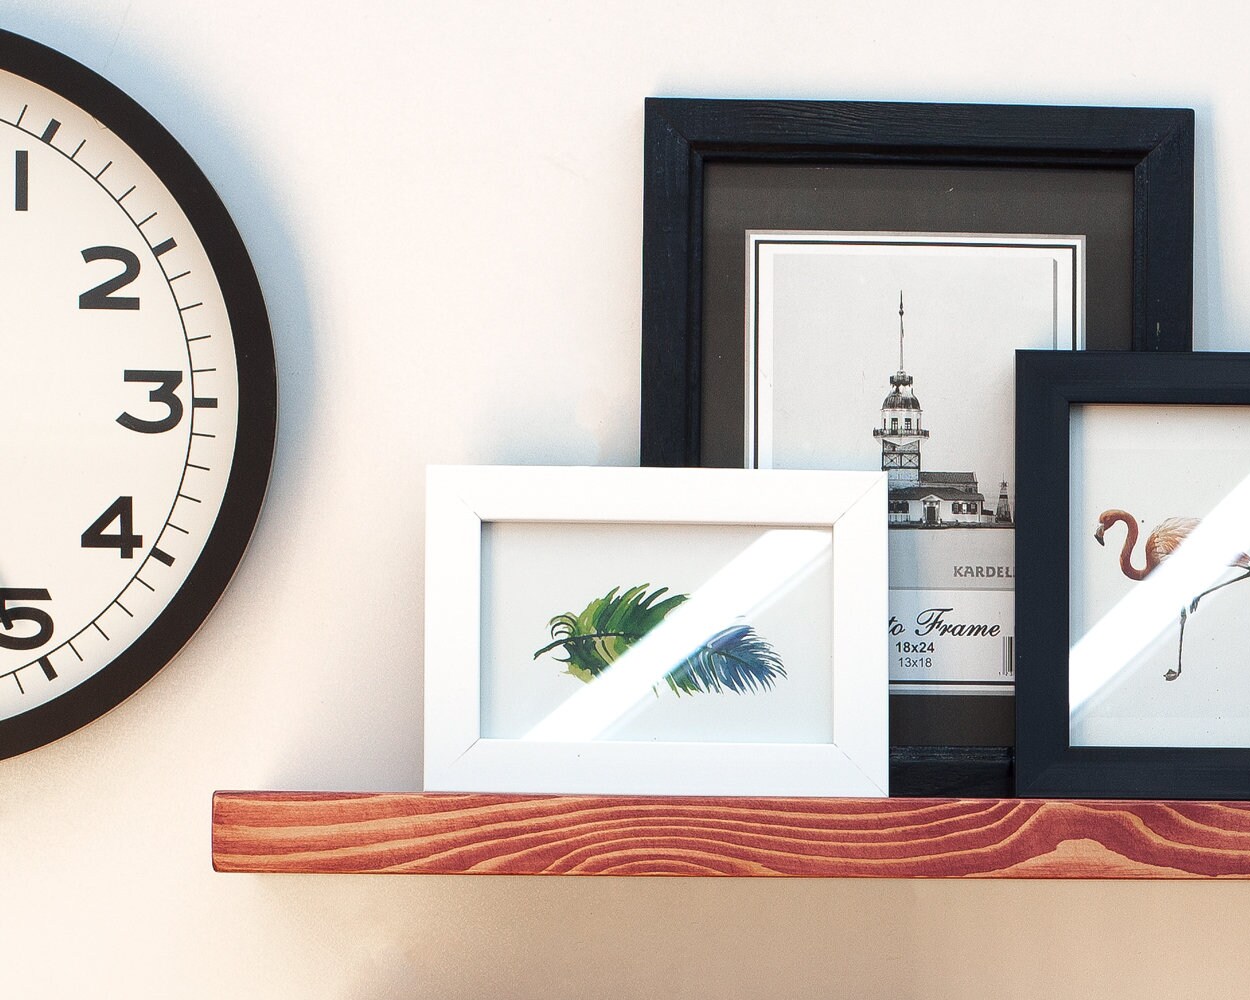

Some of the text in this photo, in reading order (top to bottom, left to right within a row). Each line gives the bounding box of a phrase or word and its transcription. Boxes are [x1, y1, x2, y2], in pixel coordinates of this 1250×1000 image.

[79, 246, 140, 309] 2
[116, 370, 183, 433] 3
[81, 497, 143, 558] 4
[953, 566, 1015, 578] KARDEL
[0, 588, 54, 650] 5
[915, 607, 1000, 637] Frame
[895, 642, 935, 653] 18x24
[898, 657, 933, 668] 13x18
